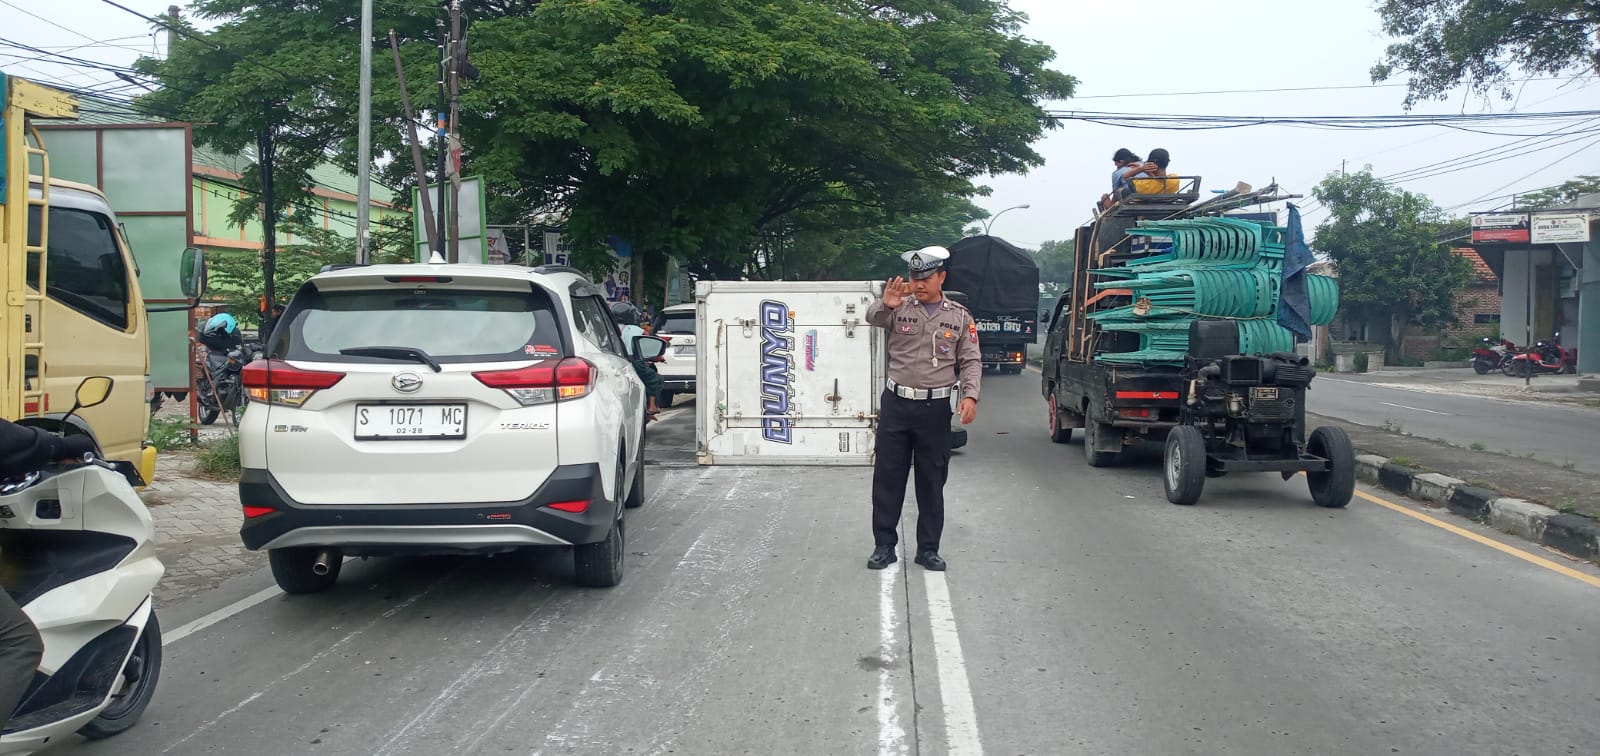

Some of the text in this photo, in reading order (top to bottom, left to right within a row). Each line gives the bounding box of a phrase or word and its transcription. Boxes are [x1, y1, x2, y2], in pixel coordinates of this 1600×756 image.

[759, 299, 792, 444] DUNYO
[360, 408, 369, 425] S
[389, 408, 423, 425] 1071
